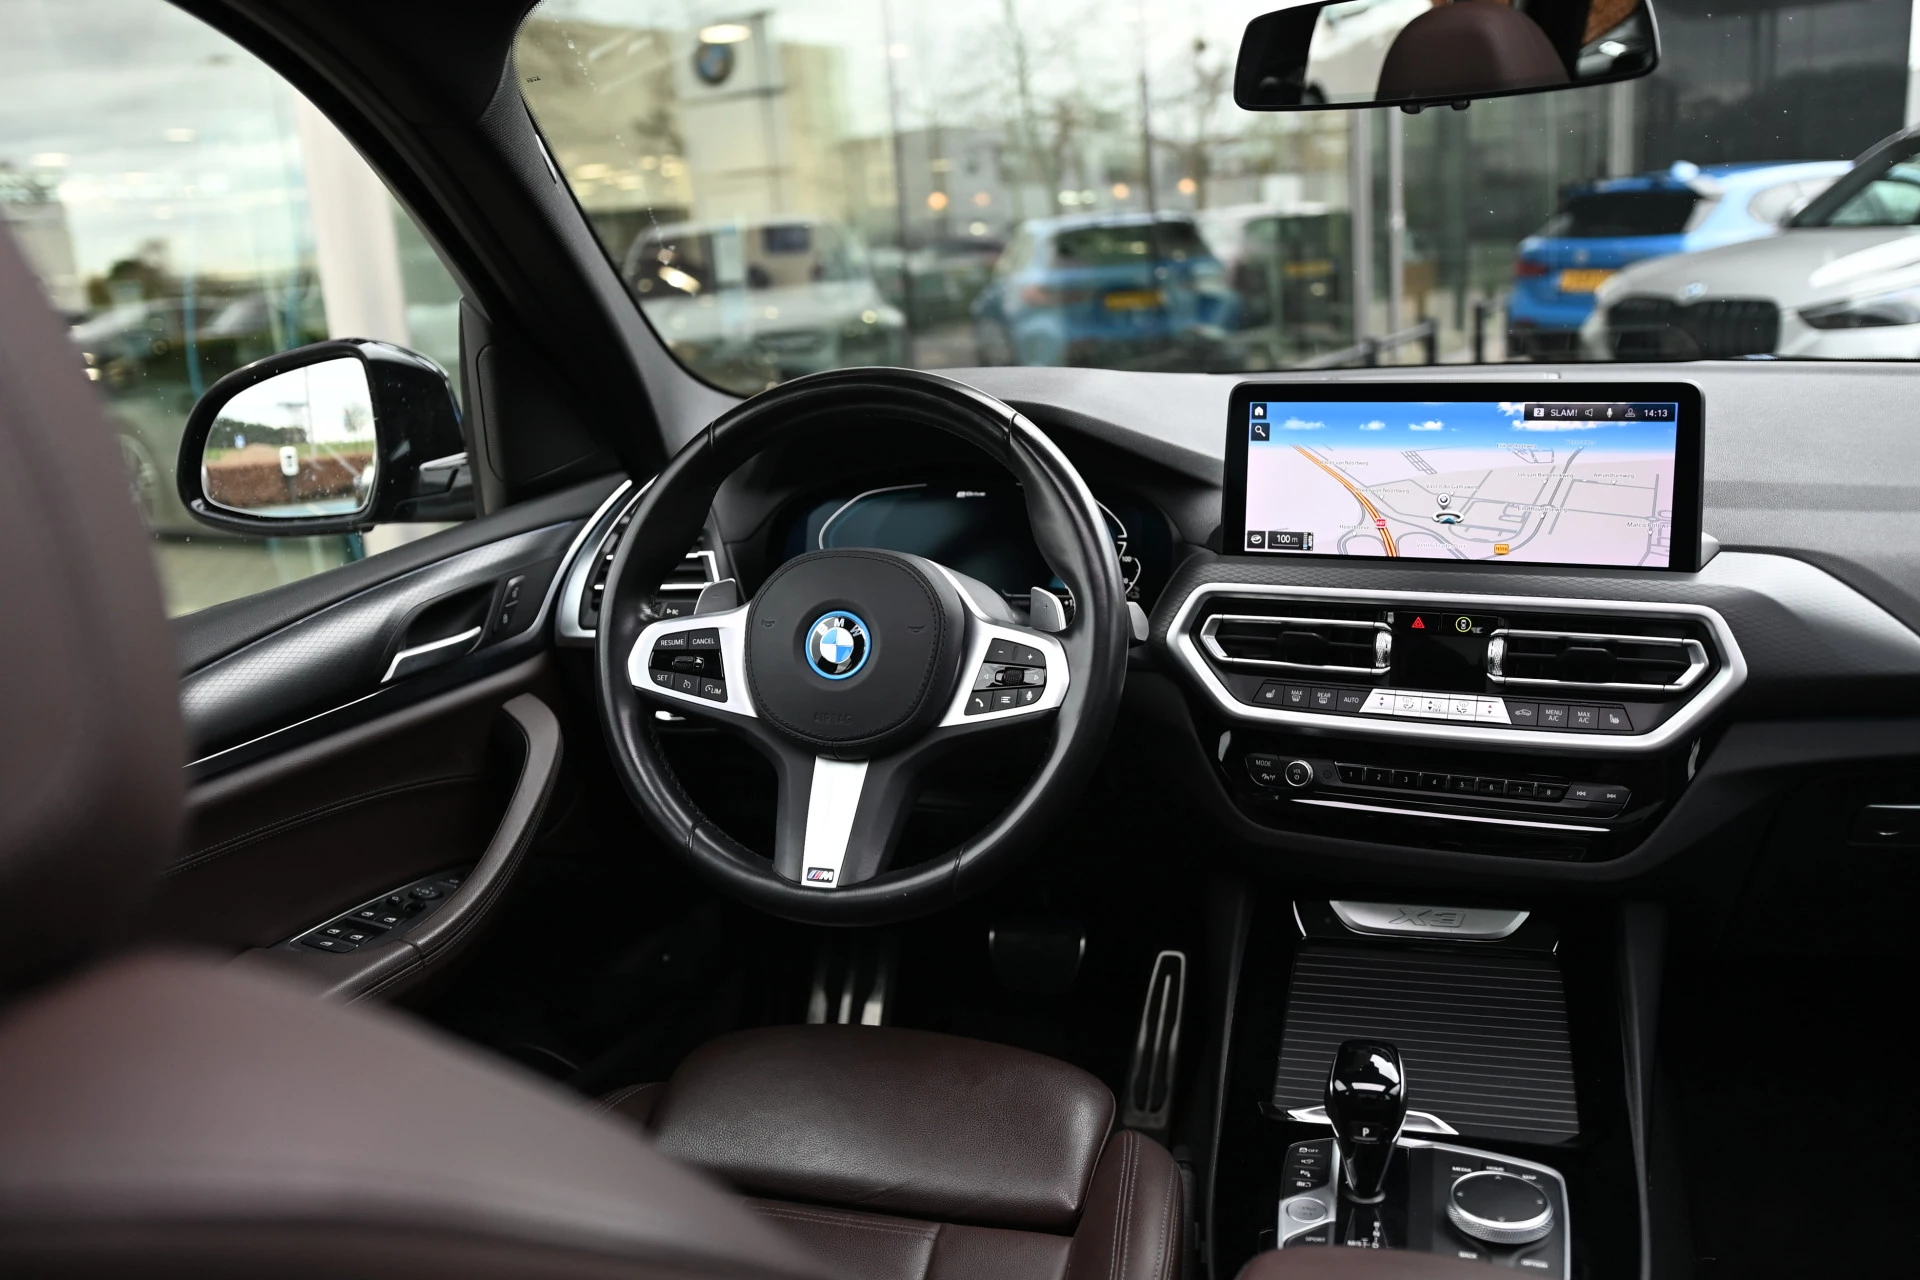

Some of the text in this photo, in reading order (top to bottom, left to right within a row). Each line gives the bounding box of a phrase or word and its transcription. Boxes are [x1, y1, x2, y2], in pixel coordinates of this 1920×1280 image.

[1550, 409, 1577, 417] SLAM!
[1644, 409, 1668, 417] 14:13
[1277, 535, 1291, 543] 100
[816, 617, 862, 638] BMW
[1343, 696, 1360, 704] AUTO
[1255, 759, 1272, 767] MODE
[1388, 907, 1466, 928] X3
[1362, 1127, 1370, 1137] P
